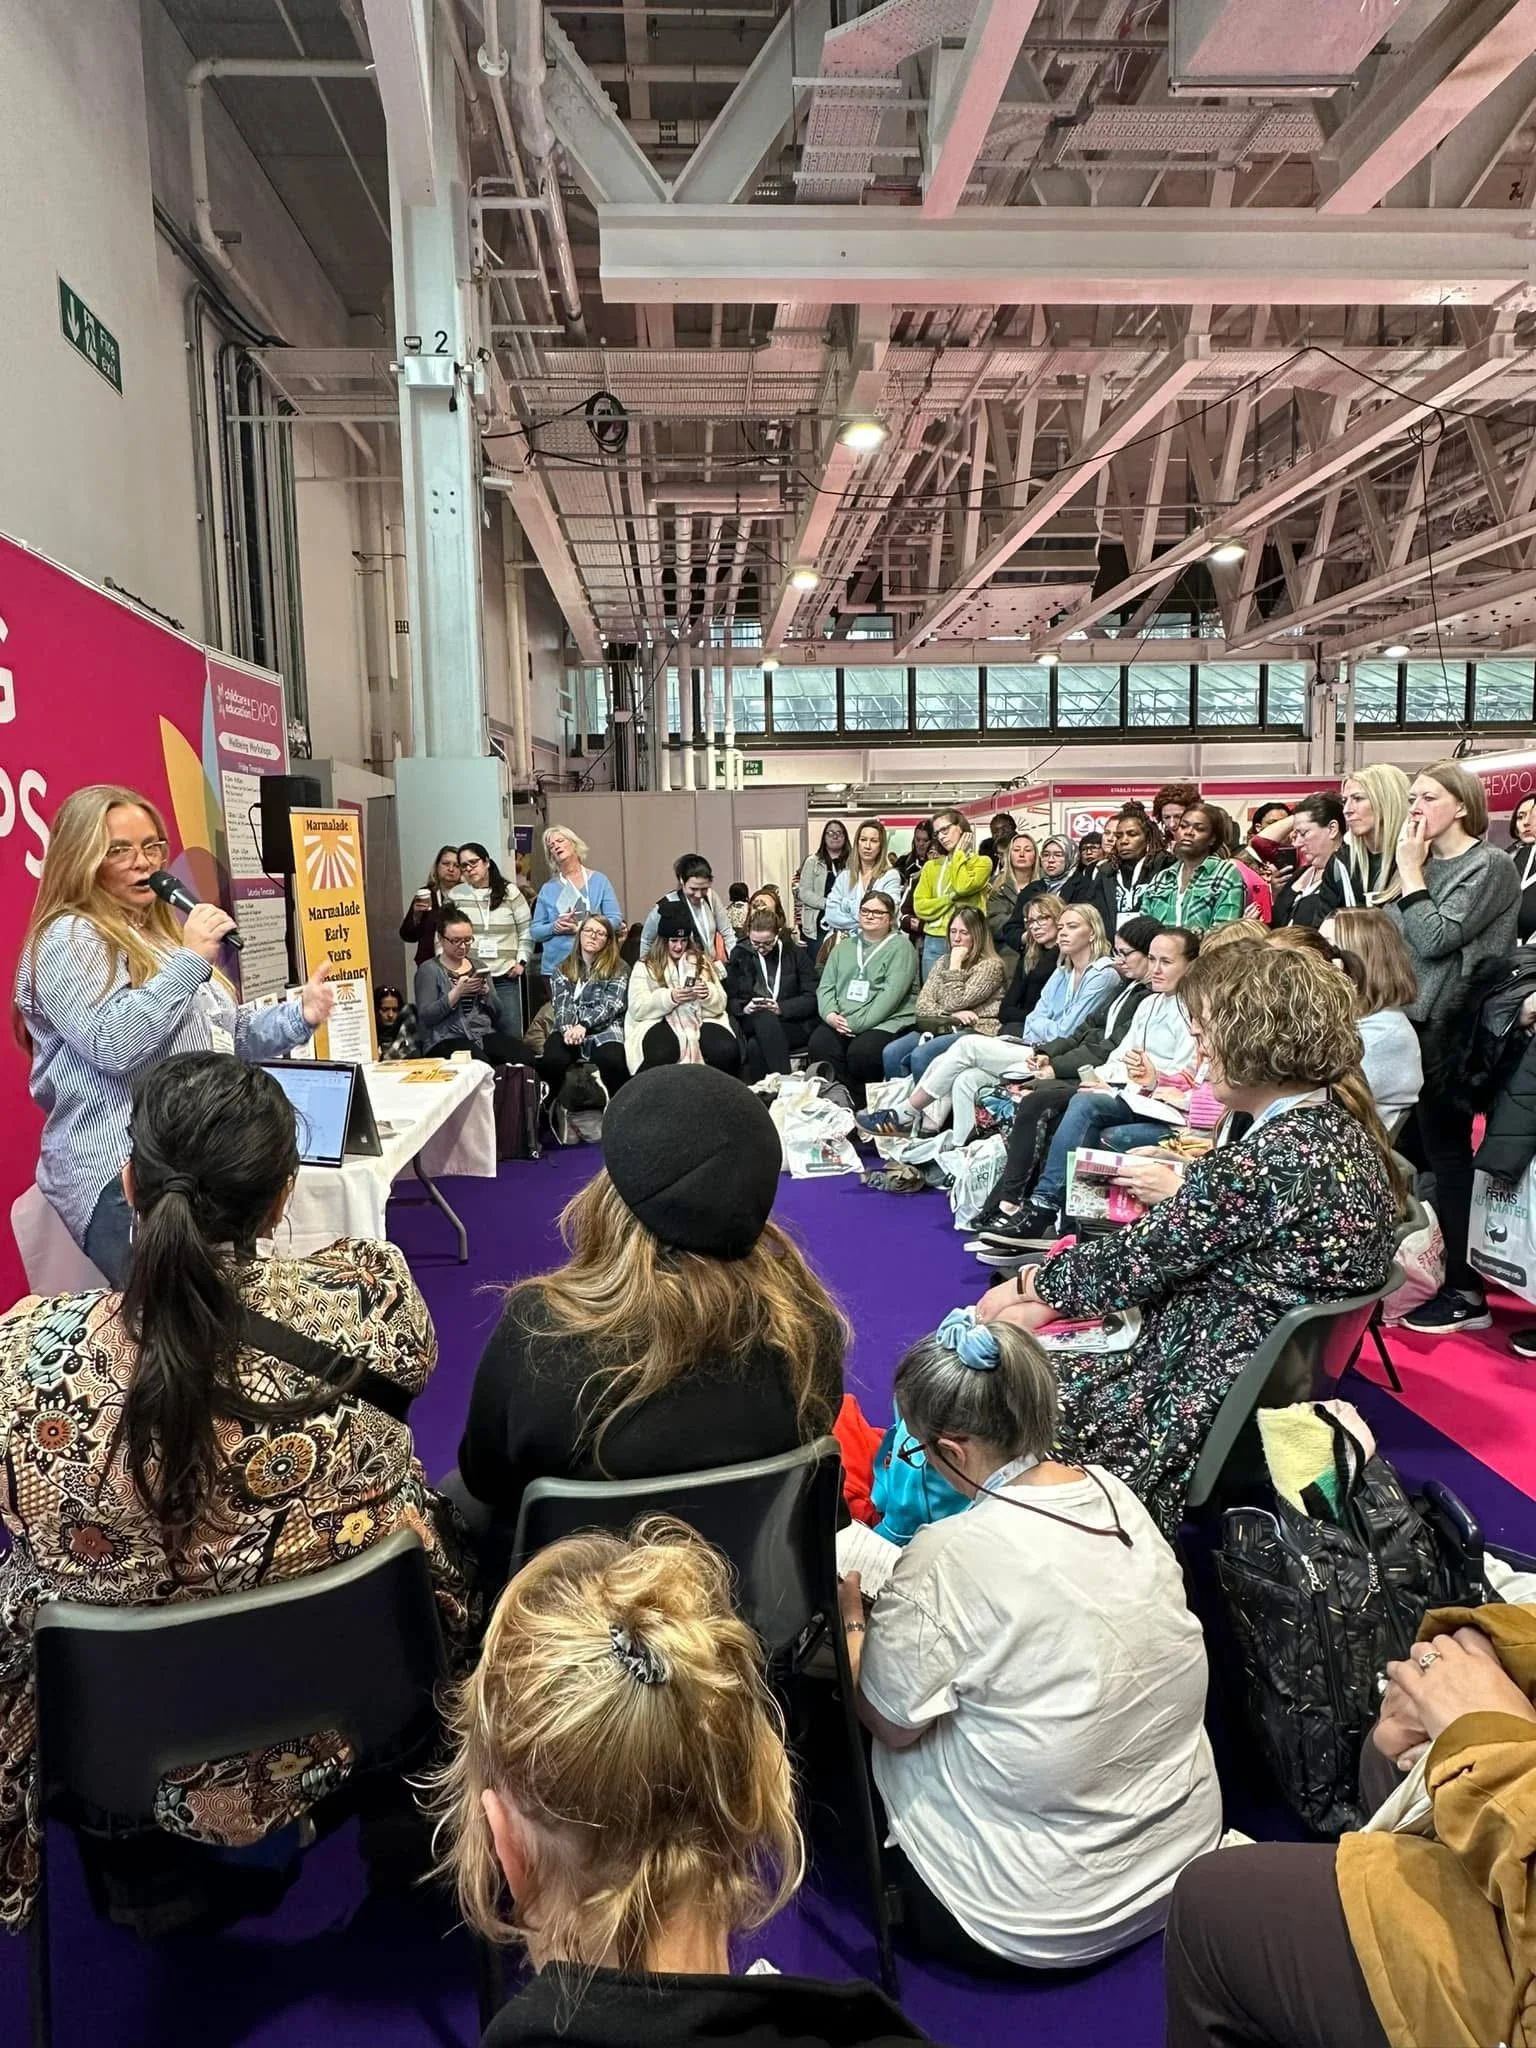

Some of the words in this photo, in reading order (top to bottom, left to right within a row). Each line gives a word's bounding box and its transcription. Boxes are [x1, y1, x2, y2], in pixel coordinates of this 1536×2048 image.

[100, 329, 116, 360] Fire
[434, 330, 449, 354] 2
[101, 357, 117, 382] exit
[251, 699, 278, 727] EXPO
[1491, 771, 1533, 796] EXPO
[305, 819, 349, 832] Marmalade
[308, 901, 361, 921] Marmalade
[325, 926, 350, 943] Early
[327, 948, 352, 963] Years
